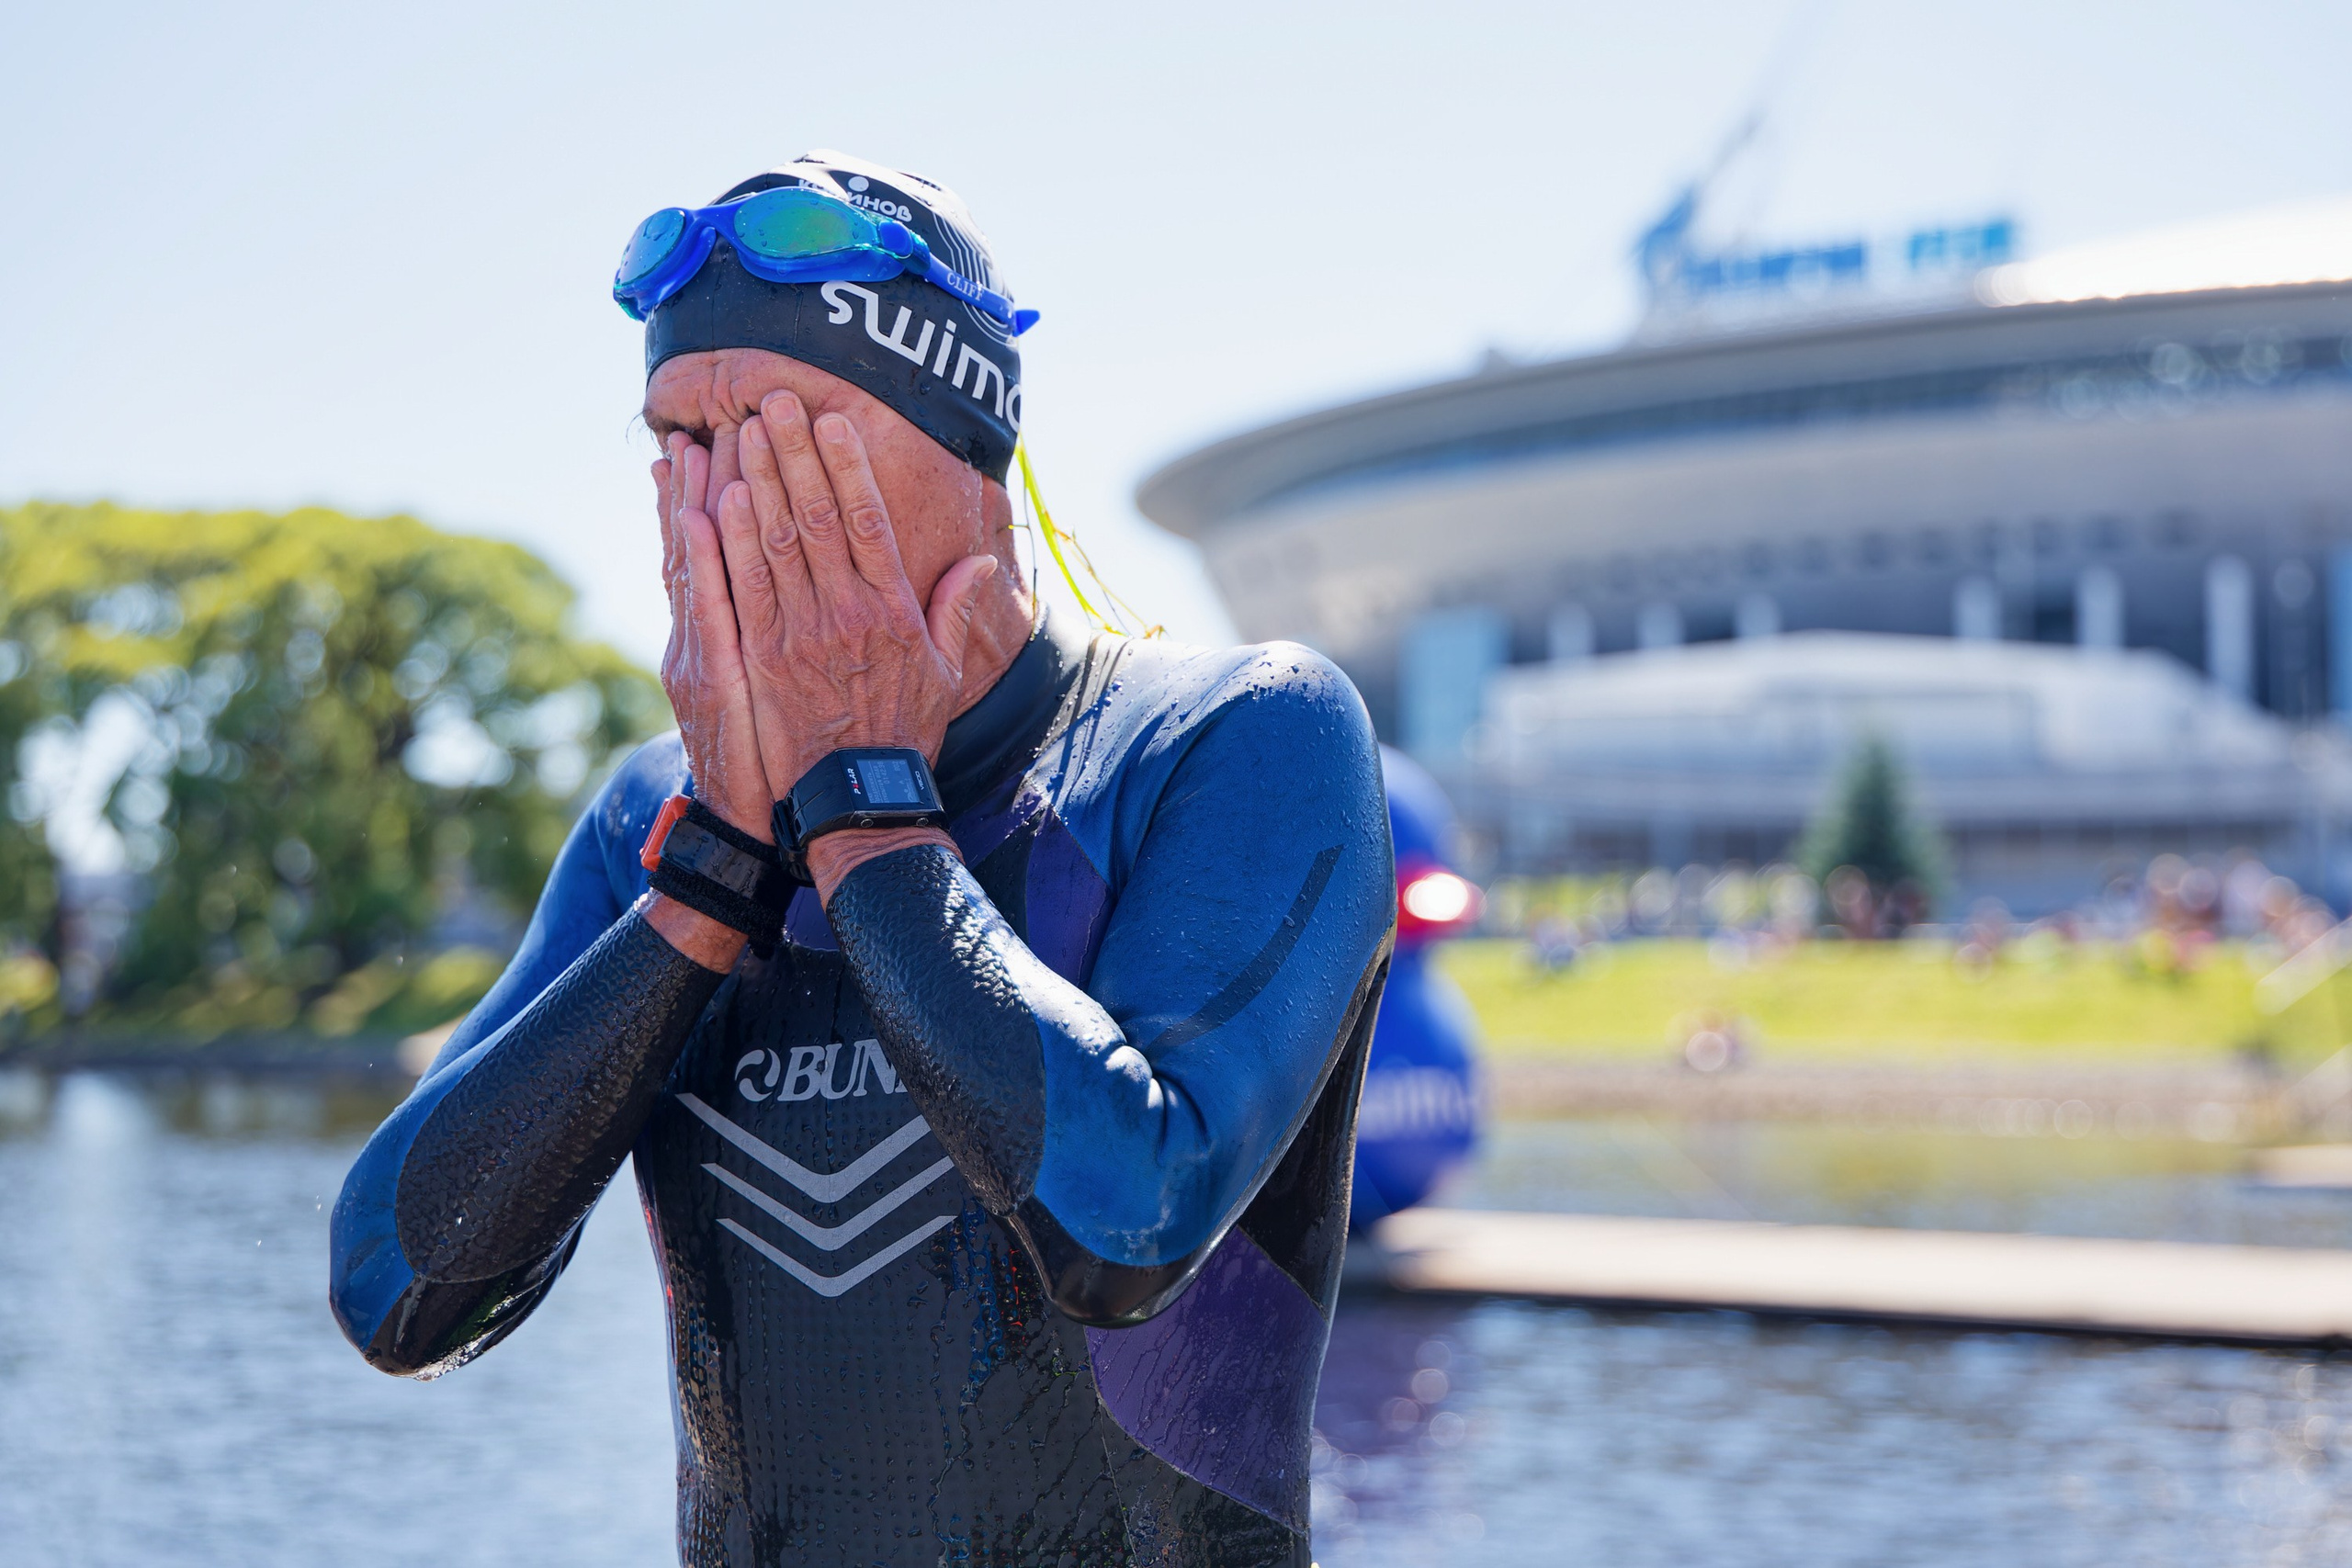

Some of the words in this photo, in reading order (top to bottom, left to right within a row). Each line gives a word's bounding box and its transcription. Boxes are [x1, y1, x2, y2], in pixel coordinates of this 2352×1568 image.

[946, 272, 985, 301] CLIFF
[847, 767, 862, 795] POLAR
[776, 1038, 909, 1101] BUN
